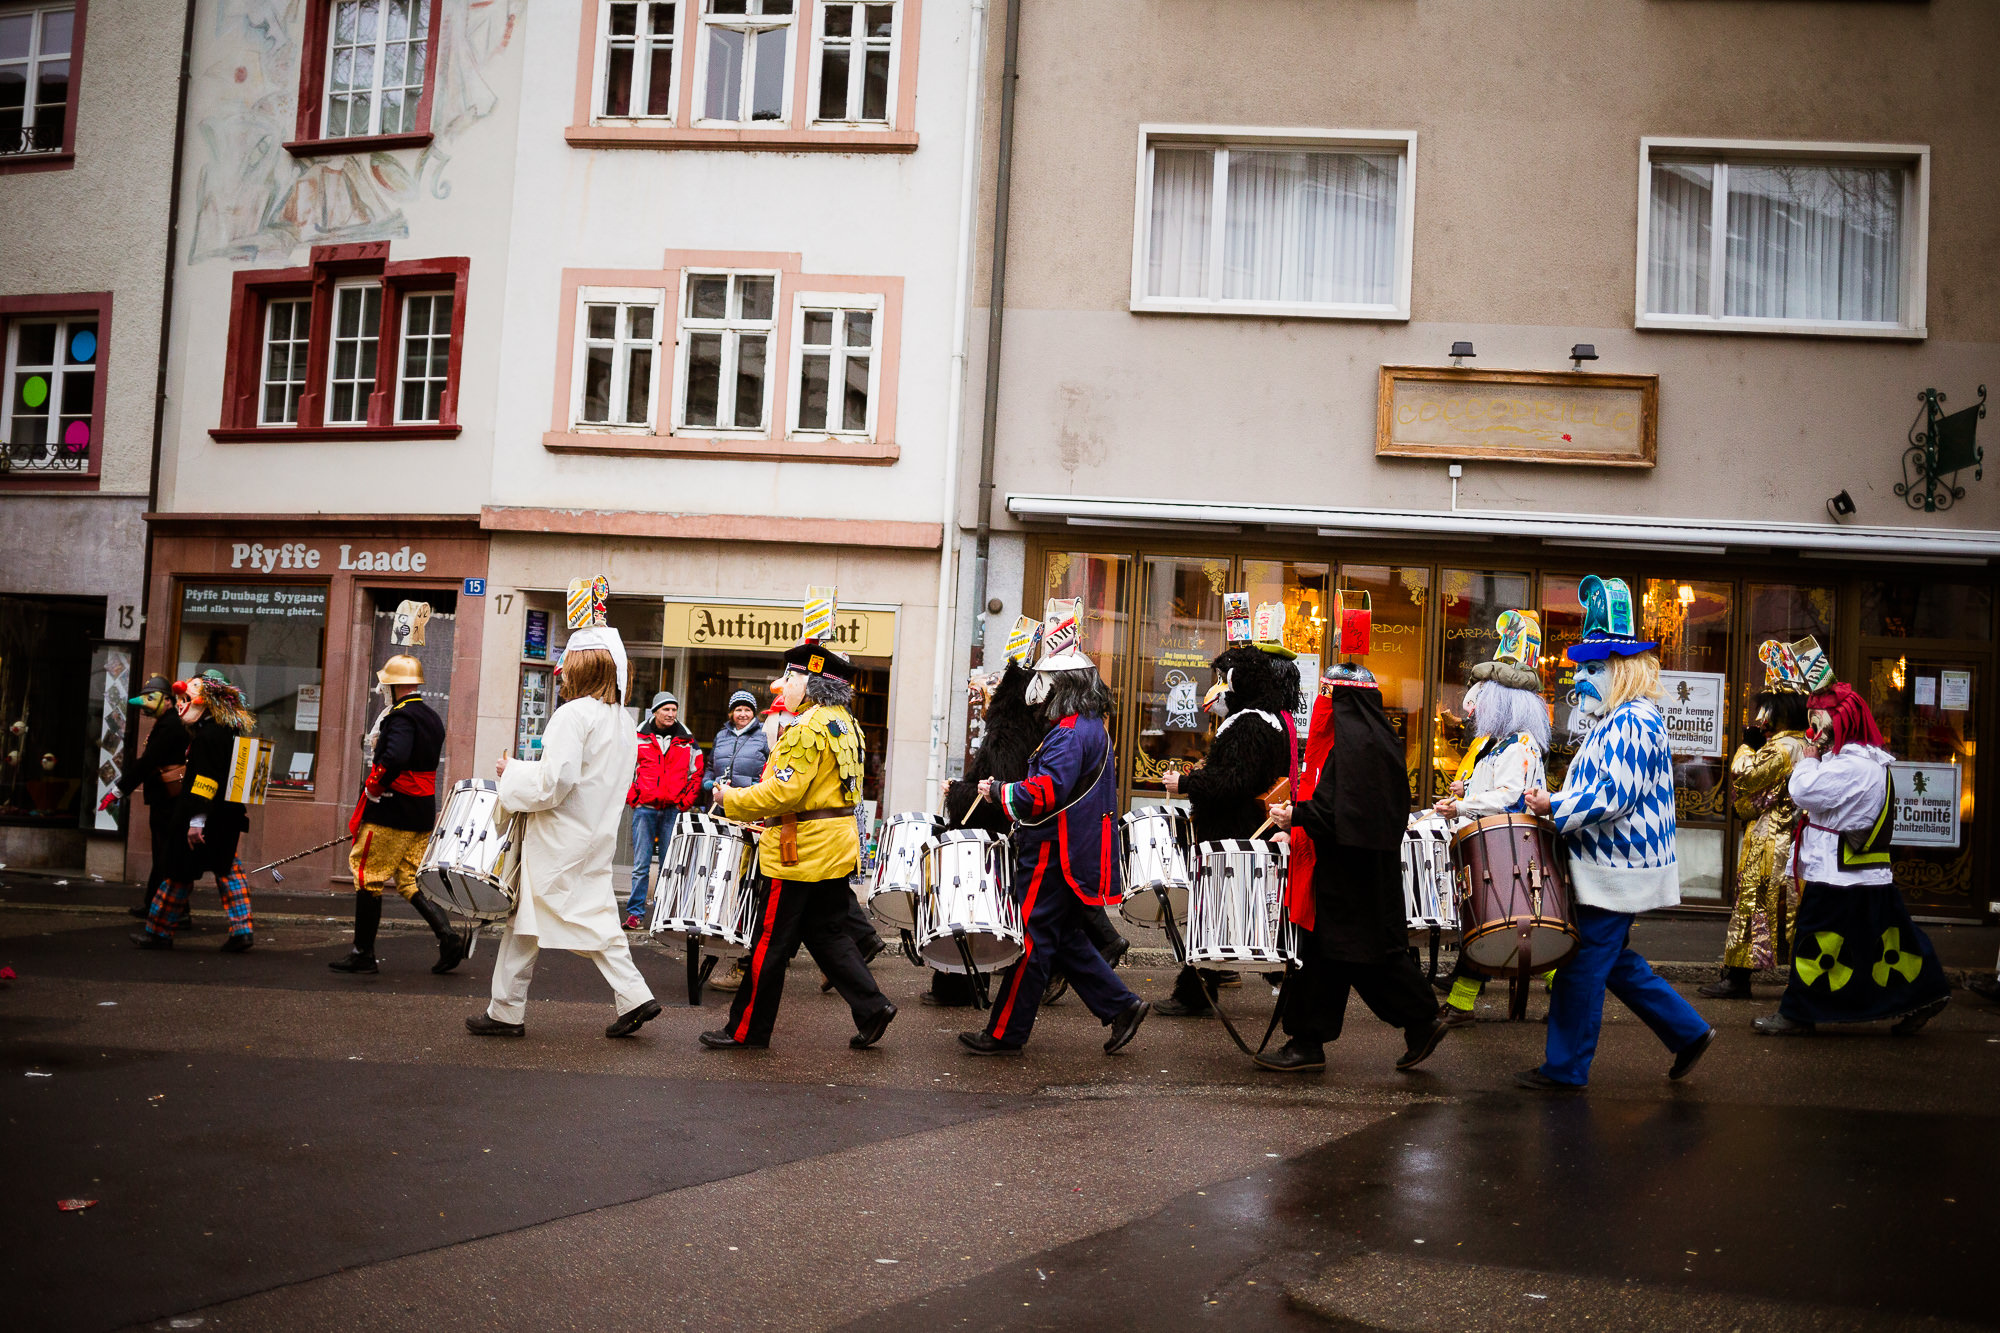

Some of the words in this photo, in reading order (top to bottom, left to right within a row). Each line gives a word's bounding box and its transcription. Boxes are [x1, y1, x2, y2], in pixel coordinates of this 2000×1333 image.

[1397, 398, 1636, 431] COCCODRILLO
[230, 543, 321, 573] Pfyffe
[338, 544, 427, 572] Laade
[469, 580, 481, 593] 15
[185, 589, 219, 601] Pfyffe
[221, 590, 269, 603] Duubagg
[273, 591, 325, 604] Syygaare
[210, 605, 230, 613] alles
[256, 606, 285, 615] derzue
[494, 594, 514, 615] 17
[118, 605, 134, 629] 13
[694, 609, 860, 646] Antiquaat
[1371, 624, 1416, 635] RDON
[1447, 628, 1501, 640] CARPAC
[1371, 641, 1403, 653] LEU
[1181, 689, 1192, 700] V
[1177, 699, 1195, 710] SG
[1668, 706, 1682, 715] ane
[1686, 706, 1715, 717] kemme
[1663, 715, 1714, 733] 'Comité
[1668, 732, 1713, 745] nitzelbängg
[1904, 797, 1919, 806] ane
[1922, 797, 1952, 808] kemme
[1894, 823, 1951, 835] chnitzelbängg
